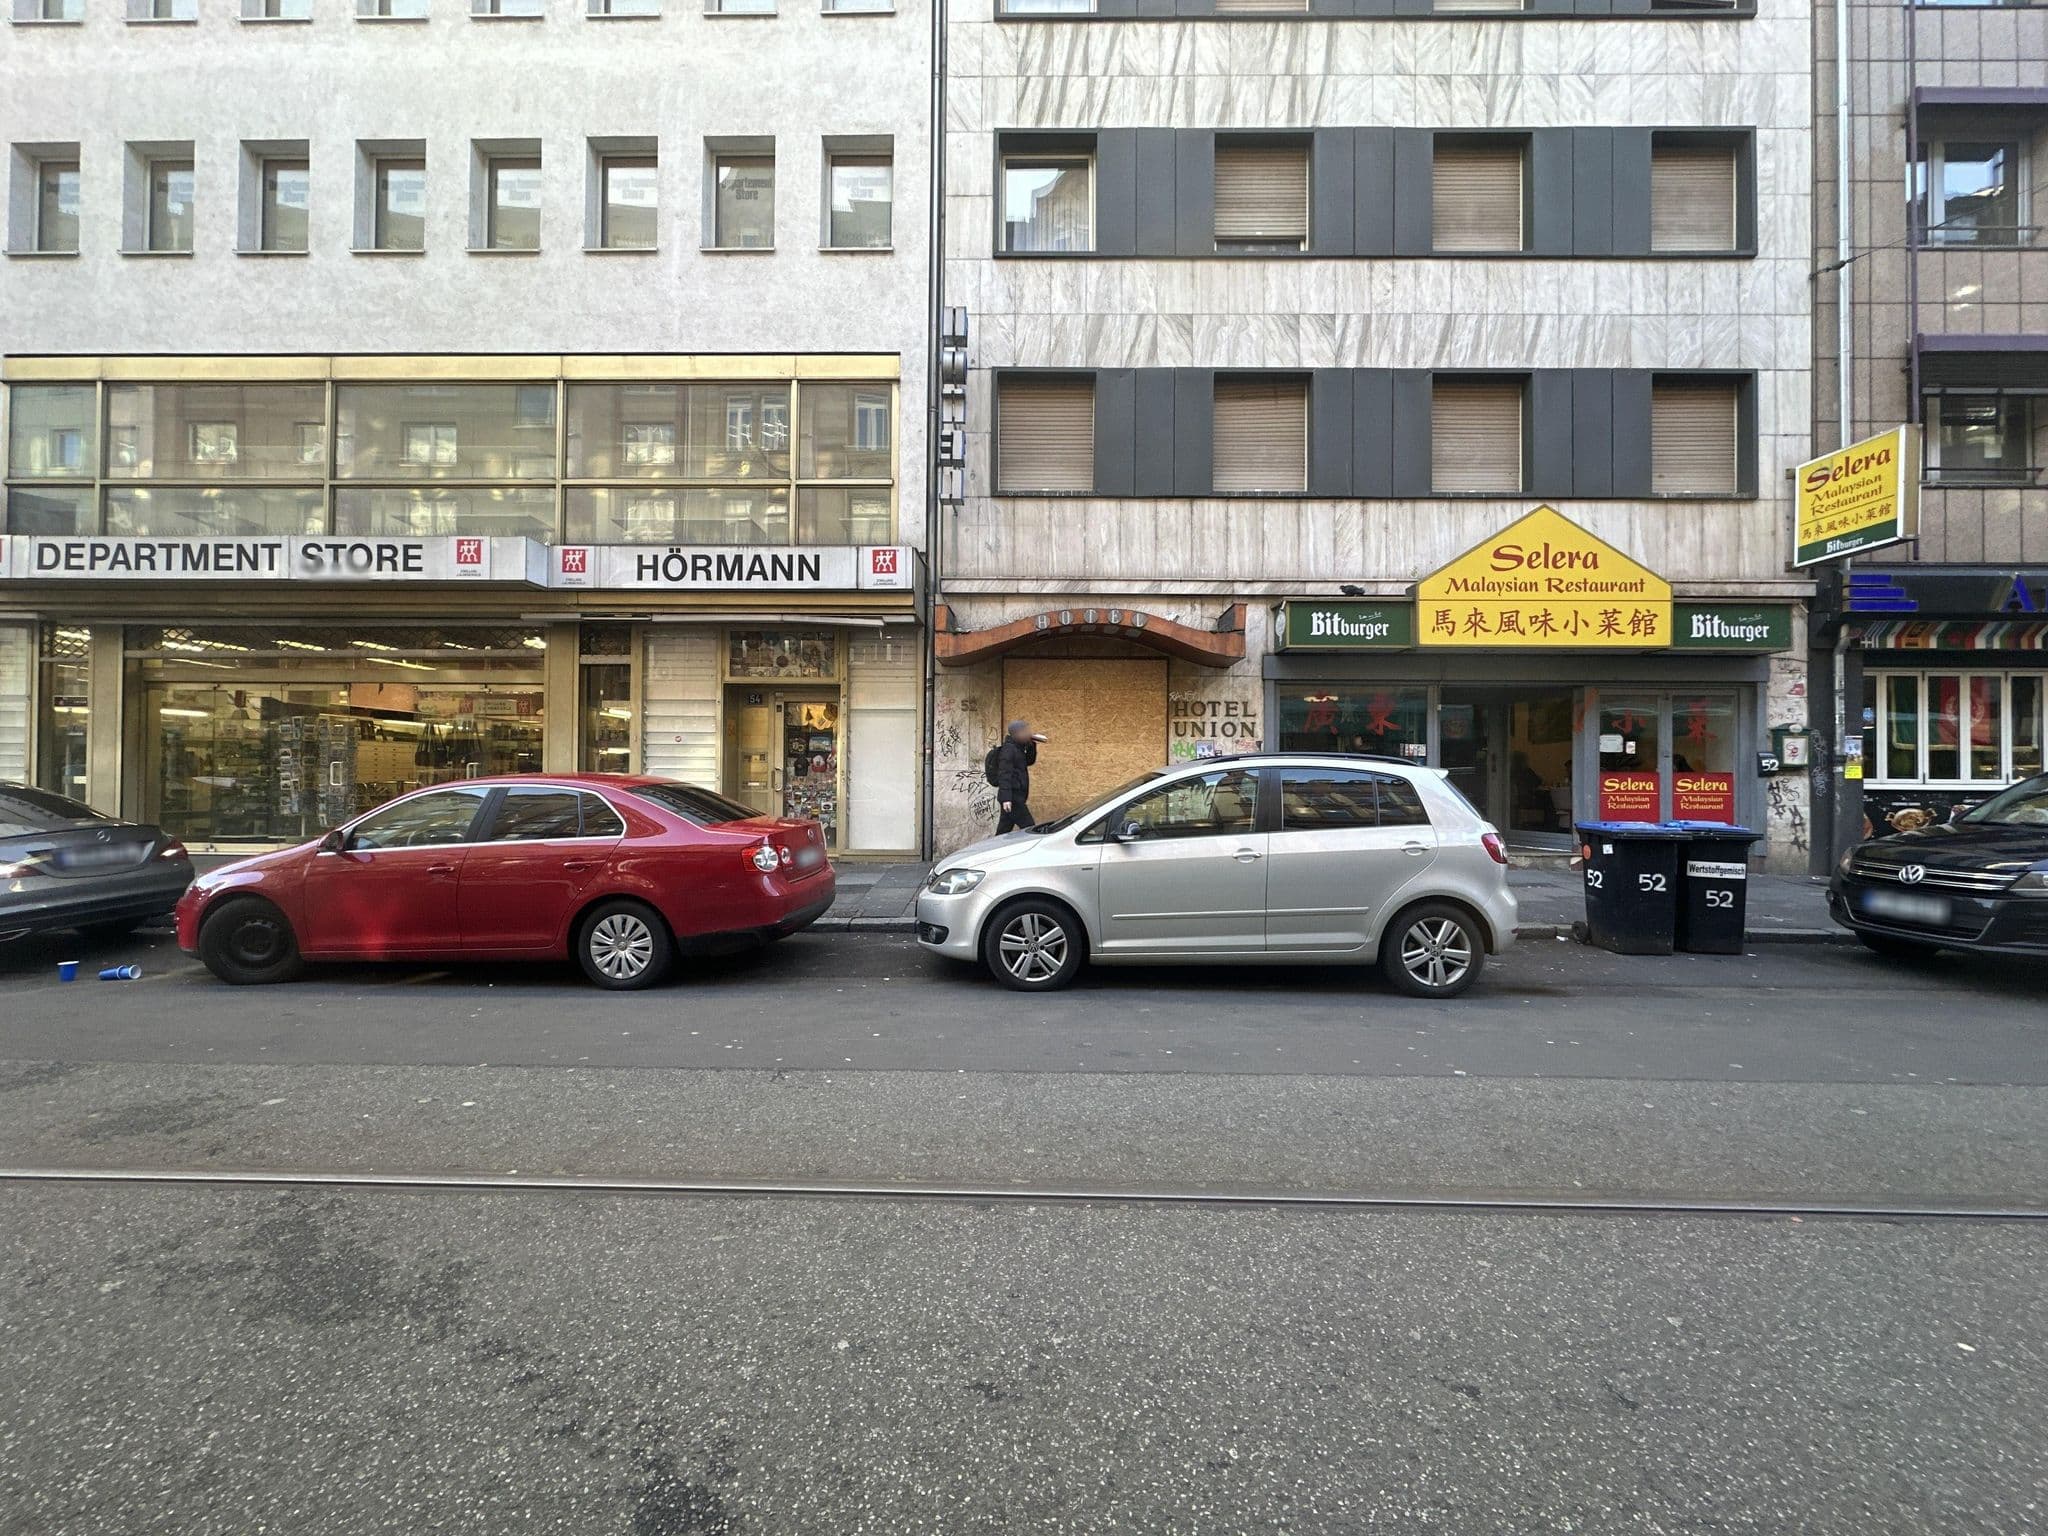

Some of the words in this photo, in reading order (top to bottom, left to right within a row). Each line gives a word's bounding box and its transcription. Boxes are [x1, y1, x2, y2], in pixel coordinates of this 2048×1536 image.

[736, 189, 758, 200] Store
[1806, 448, 1892, 493] Selera
[1811, 474, 1882, 506] Malaysian
[1811, 484, 1883, 516] Restaurant
[37, 543, 282, 571] DEPARTMENT
[301, 543, 423, 572] STORE
[636, 547, 821, 582] HÖRMANN
[1490, 542, 1600, 572] Selera
[1444, 576, 1539, 596] Malaysian
[1545, 577, 1646, 594] Restaurant
[1036, 608, 1143, 630] HOTEL
[1310, 611, 1389, 639] Bitburger
[1431, 607, 1659, 638] 馬來風味小菜館
[1690, 613, 1770, 642] Bitburger
[1172, 701, 1257, 717] HOTEL
[1173, 721, 1257, 738] UNION
[1761, 759, 1779, 771] 52
[1603, 777, 1655, 792] Selera
[1675, 777, 1728, 792] Selera
[1608, 795, 1650, 803] Malaysian
[1608, 802, 1650, 810] Restaurant
[1680, 795, 1723, 803] Malaysian
[1680, 802, 1724, 810] Restaurant
[1587, 869, 1603, 889] 52
[1688, 863, 1745, 877] Wertstoffgemisch
[1639, 873, 1667, 892] 52
[1705, 890, 1734, 908] 52
